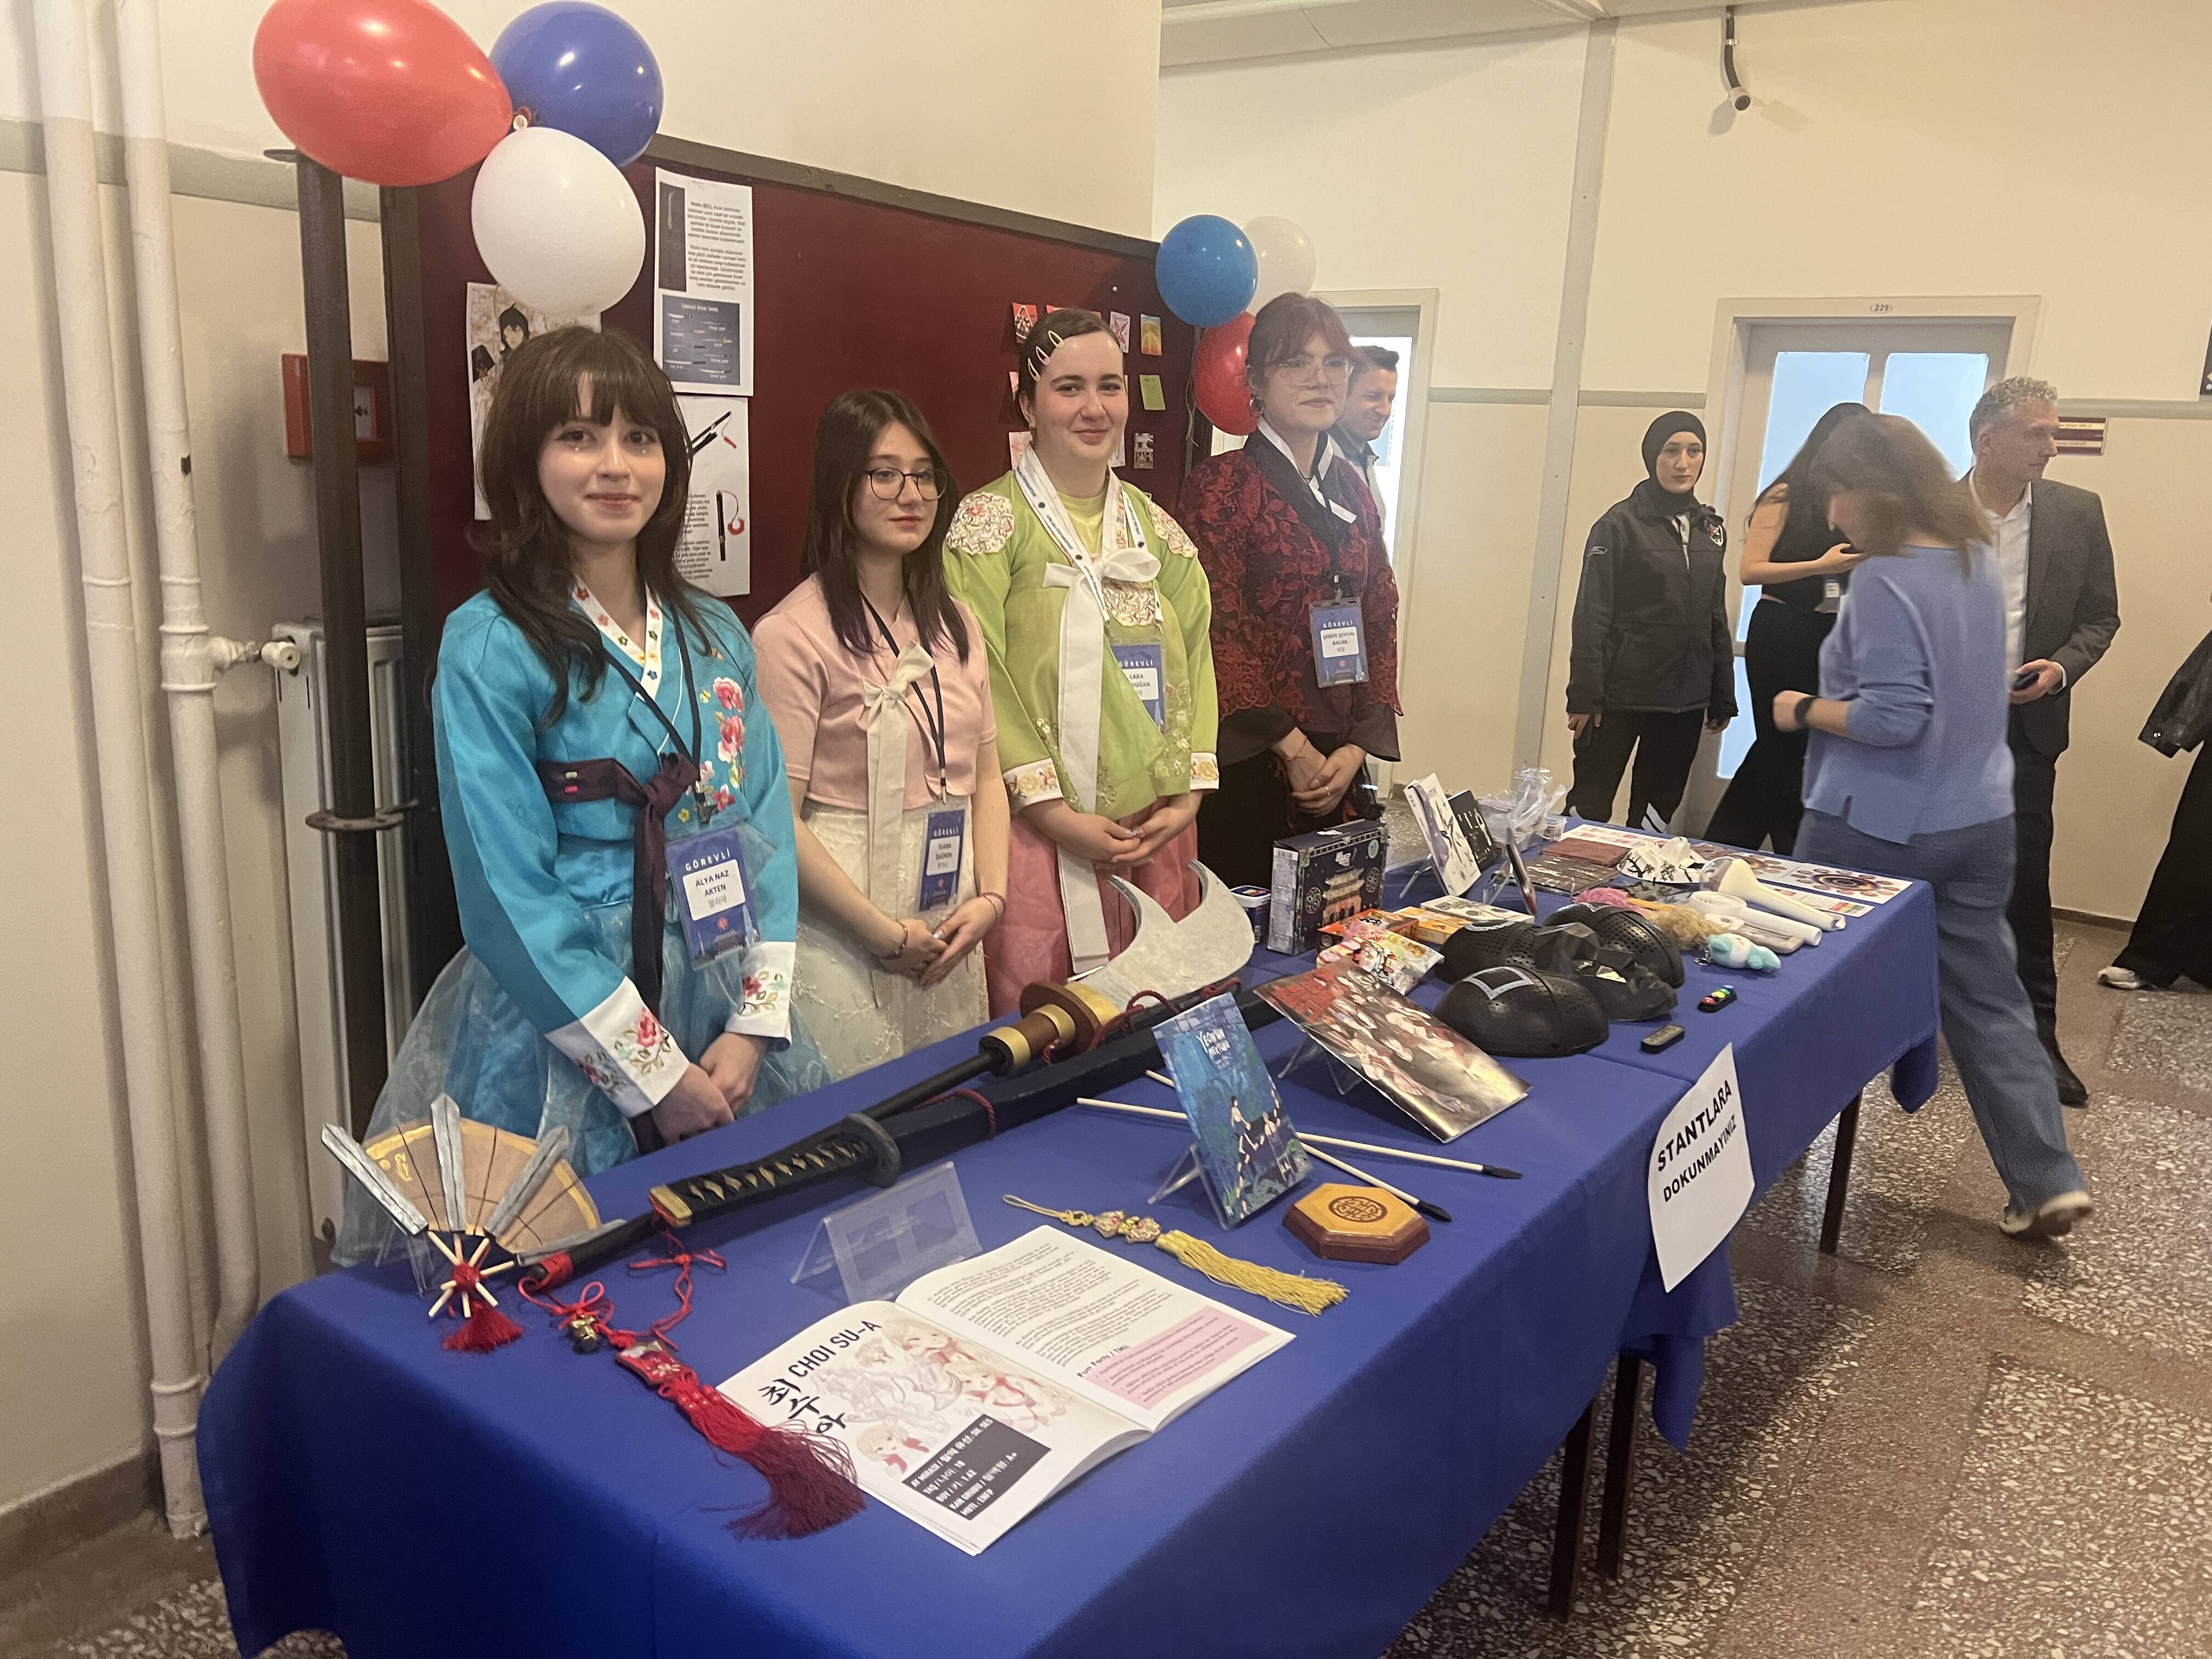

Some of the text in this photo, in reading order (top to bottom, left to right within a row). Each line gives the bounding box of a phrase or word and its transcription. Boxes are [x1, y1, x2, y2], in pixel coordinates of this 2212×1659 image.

[1323, 619, 1352, 628] GÖREVLİ
[685, 847, 731, 871] GÖREVLİ
[696, 870, 729, 887] ALYA NAZ
[704, 884, 726, 897] AKTEN
[1657, 1079, 1733, 1172] STANTLARA
[1663, 1113, 1737, 1203] DOKUNMAYINIZ
[788, 1320, 882, 1378] CHOI SU-A
